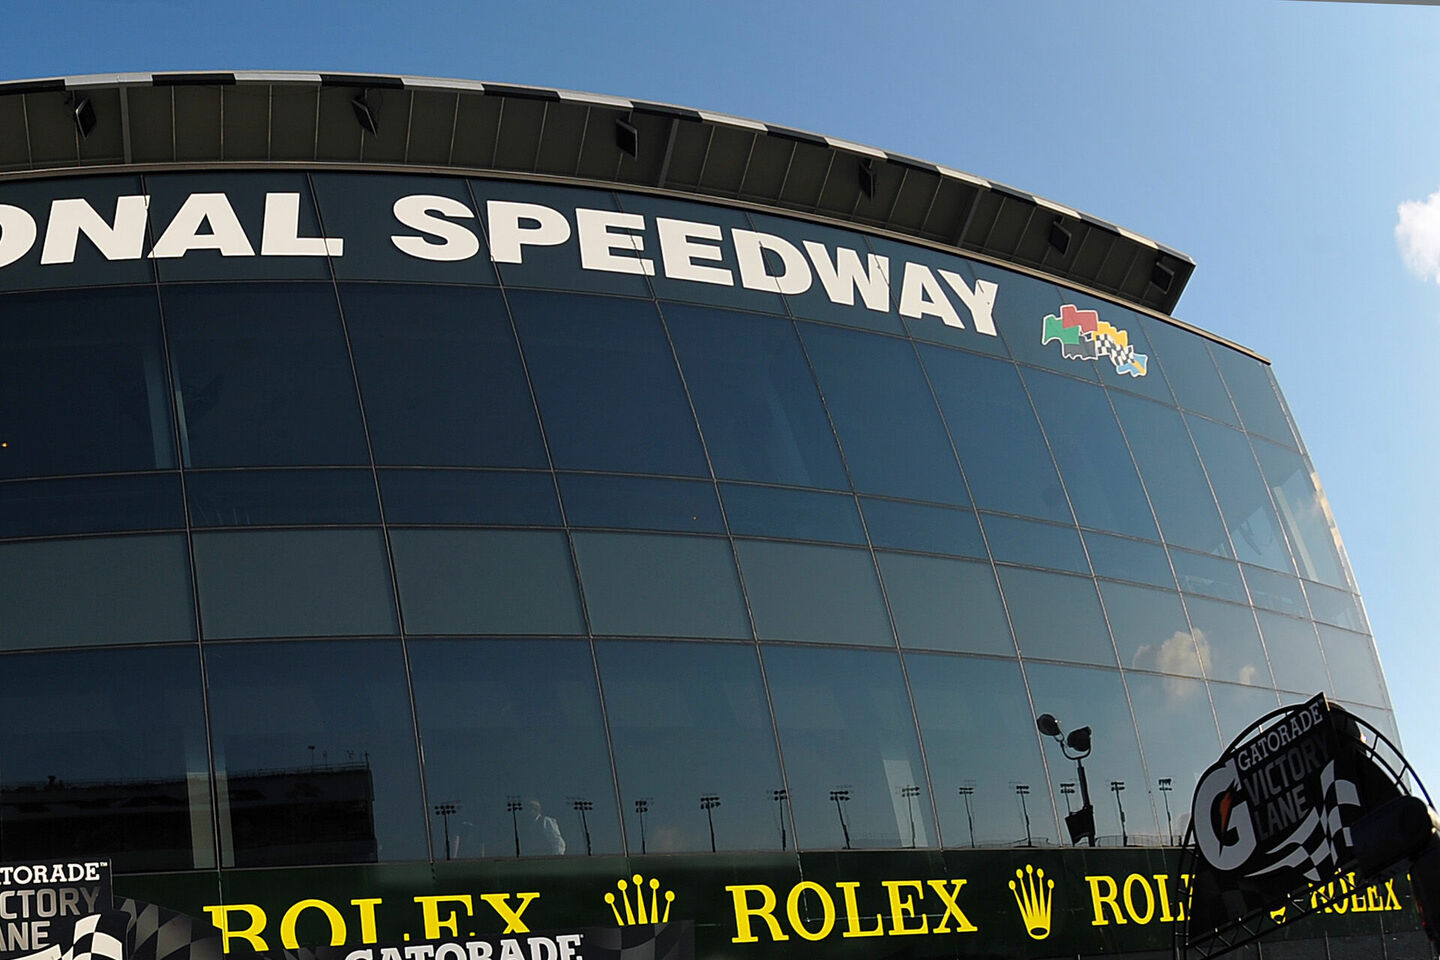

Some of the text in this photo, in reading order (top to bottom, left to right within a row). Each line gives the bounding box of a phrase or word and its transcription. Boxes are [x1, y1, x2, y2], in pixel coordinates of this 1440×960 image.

[390, 195, 999, 336] SPEEDWAY
[1194, 757, 1258, 871] G
[1254, 782, 1307, 842] LANE
[725, 879, 978, 944] ROLEX
